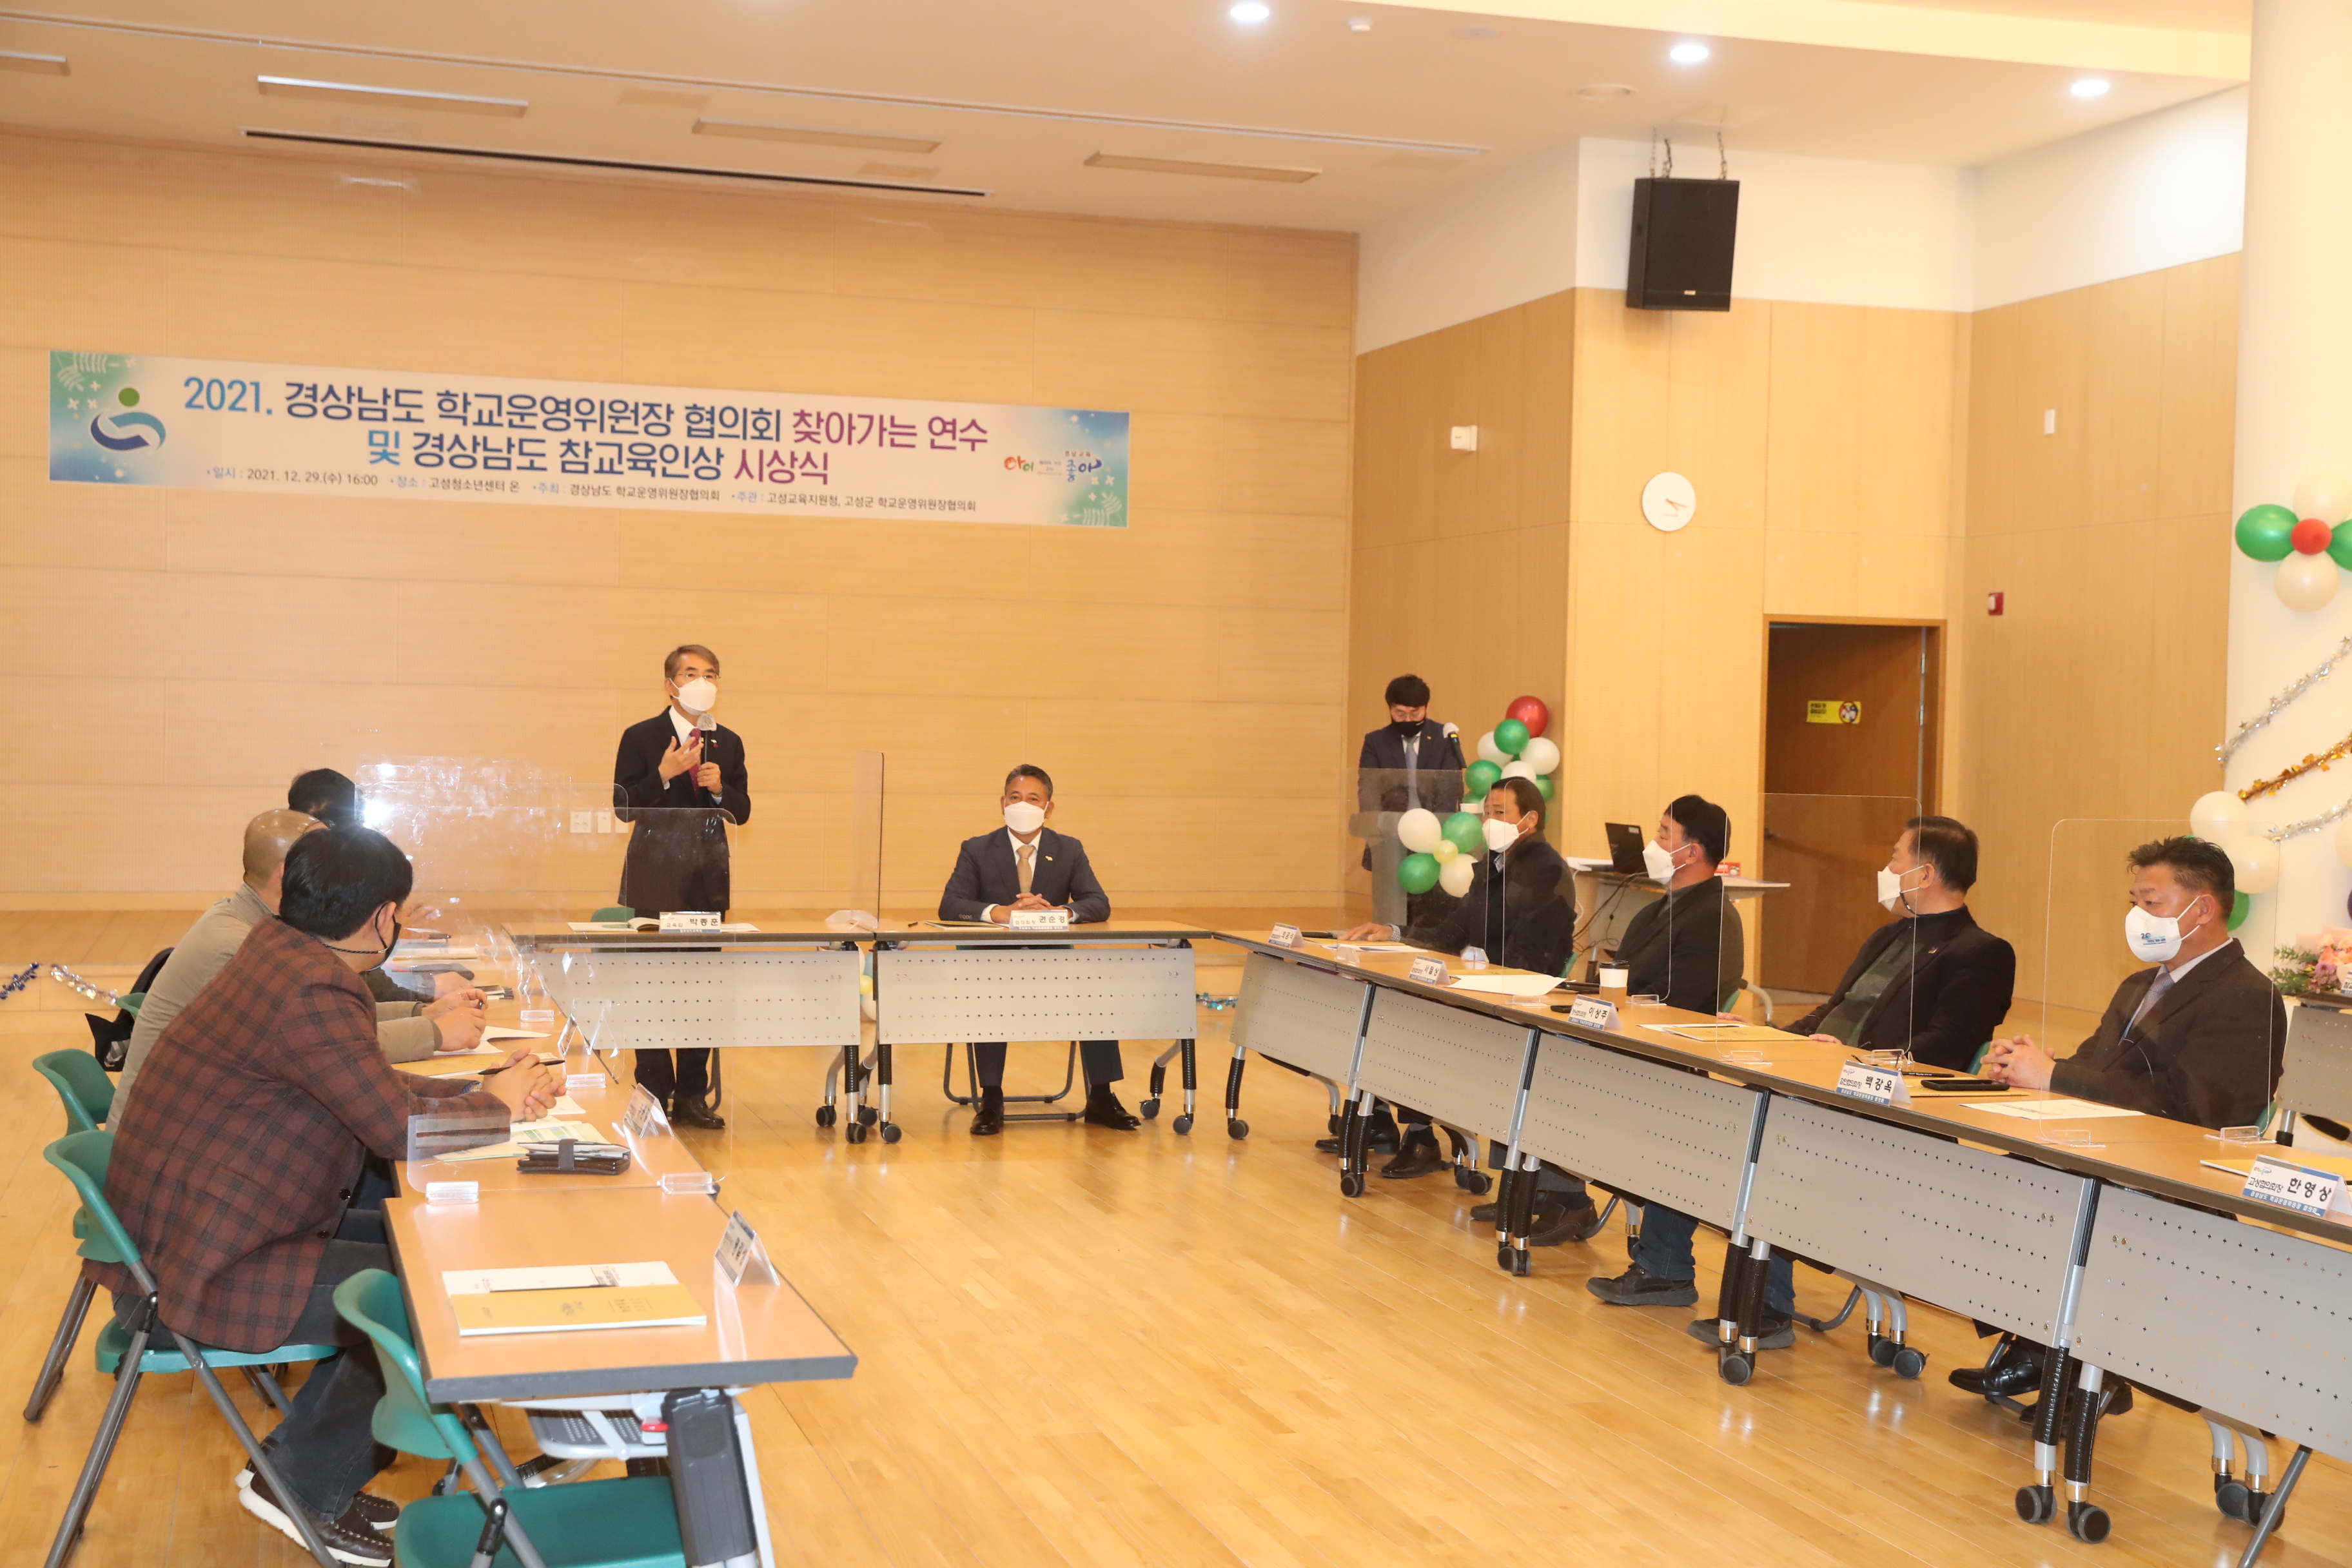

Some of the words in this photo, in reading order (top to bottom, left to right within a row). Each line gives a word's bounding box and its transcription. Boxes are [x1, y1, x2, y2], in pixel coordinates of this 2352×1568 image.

[184, 377, 273, 415] 2021.
[285, 381, 425, 423] 경상남도
[436, 389, 674, 437] 학교운영위원장
[685, 403, 781, 442] 협의회
[792, 408, 917, 449] 찾아가는
[928, 416, 988, 452] 연수
[368, 429, 401, 466] 및
[413, 431, 548, 472] 경상남도
[559, 438, 724, 481] 참교육인상
[734, 449, 828, 485] 시상식
[347, 473, 378, 486] 16:00
[429, 476, 505, 493] 고성청소년센터
[570, 484, 612, 497] 경상남도
[616, 485, 720, 502] 학교운영위원장협의회
[845, 495, 874, 508] 고성군
[878, 497, 977, 512] 학교운영위원장협의회
[1589, 1006, 1609, 1020] 이상주
[1865, 1075, 1893, 1093] 백강옥
[2248, 1177, 2284, 1193] 고성협의회장
[2287, 1177, 2332, 1202] 한영상
